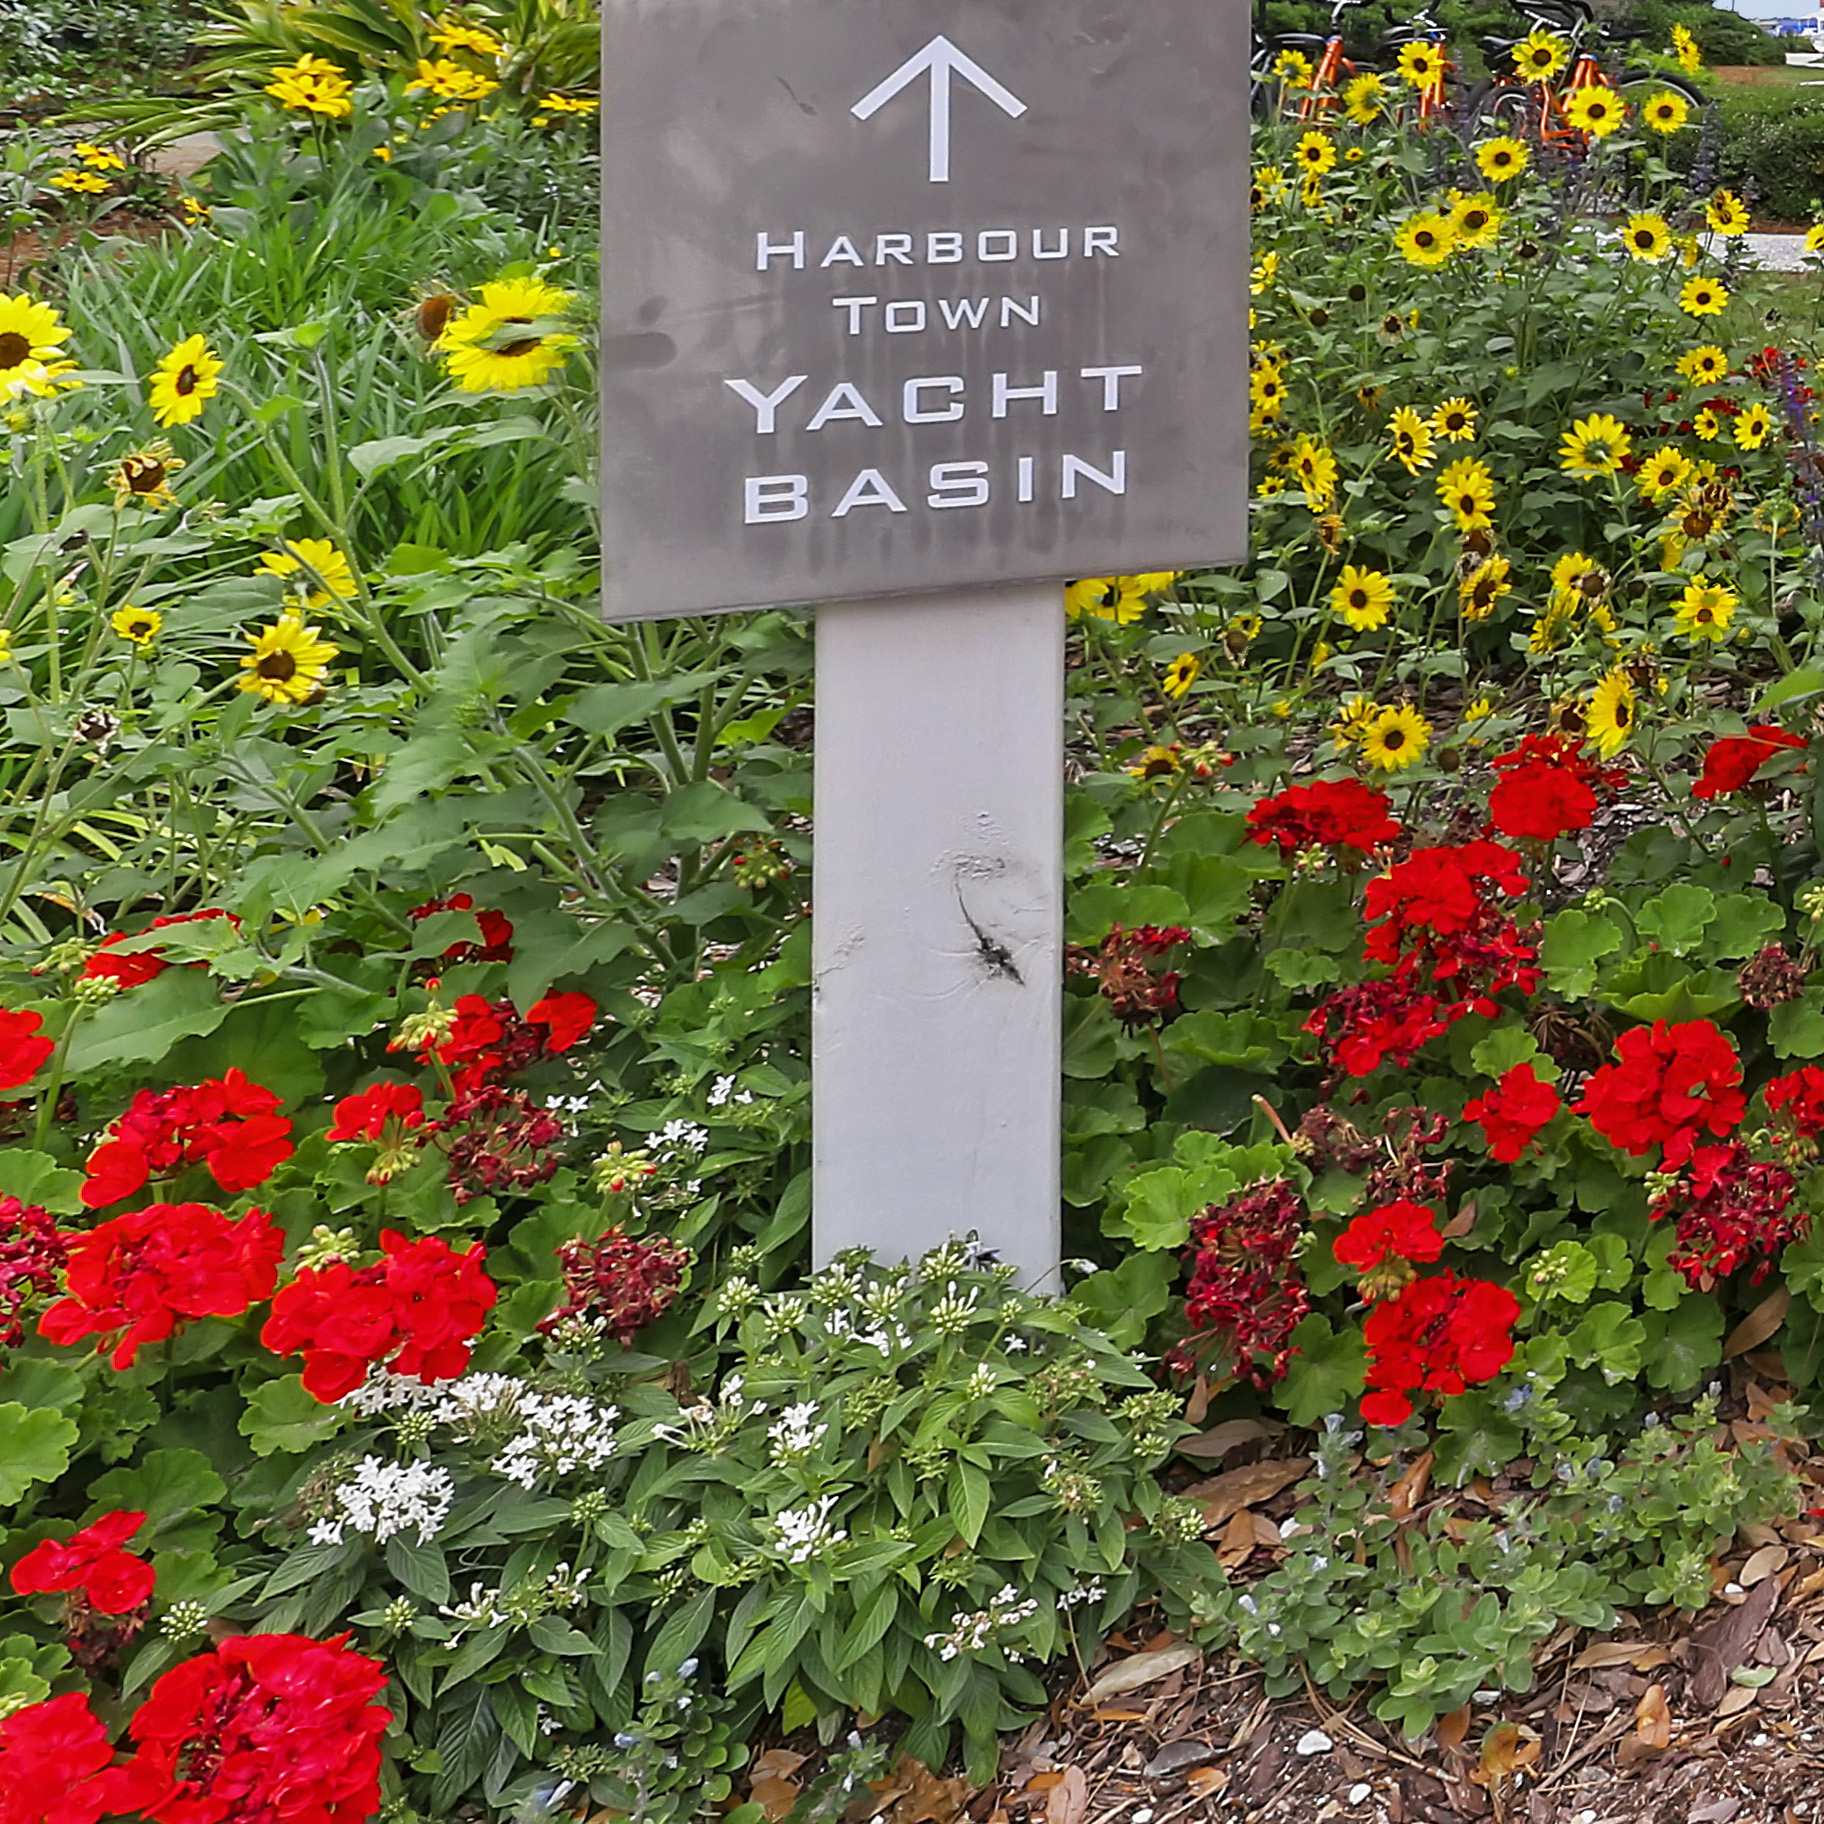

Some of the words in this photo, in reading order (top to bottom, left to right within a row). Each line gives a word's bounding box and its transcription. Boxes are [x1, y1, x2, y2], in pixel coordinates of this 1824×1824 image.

[755, 225, 1120, 271] HARBOUR
[831, 294, 1040, 335] TOWN
[723, 364, 1143, 434] YACHT
[743, 449, 1127, 525] BASIN
